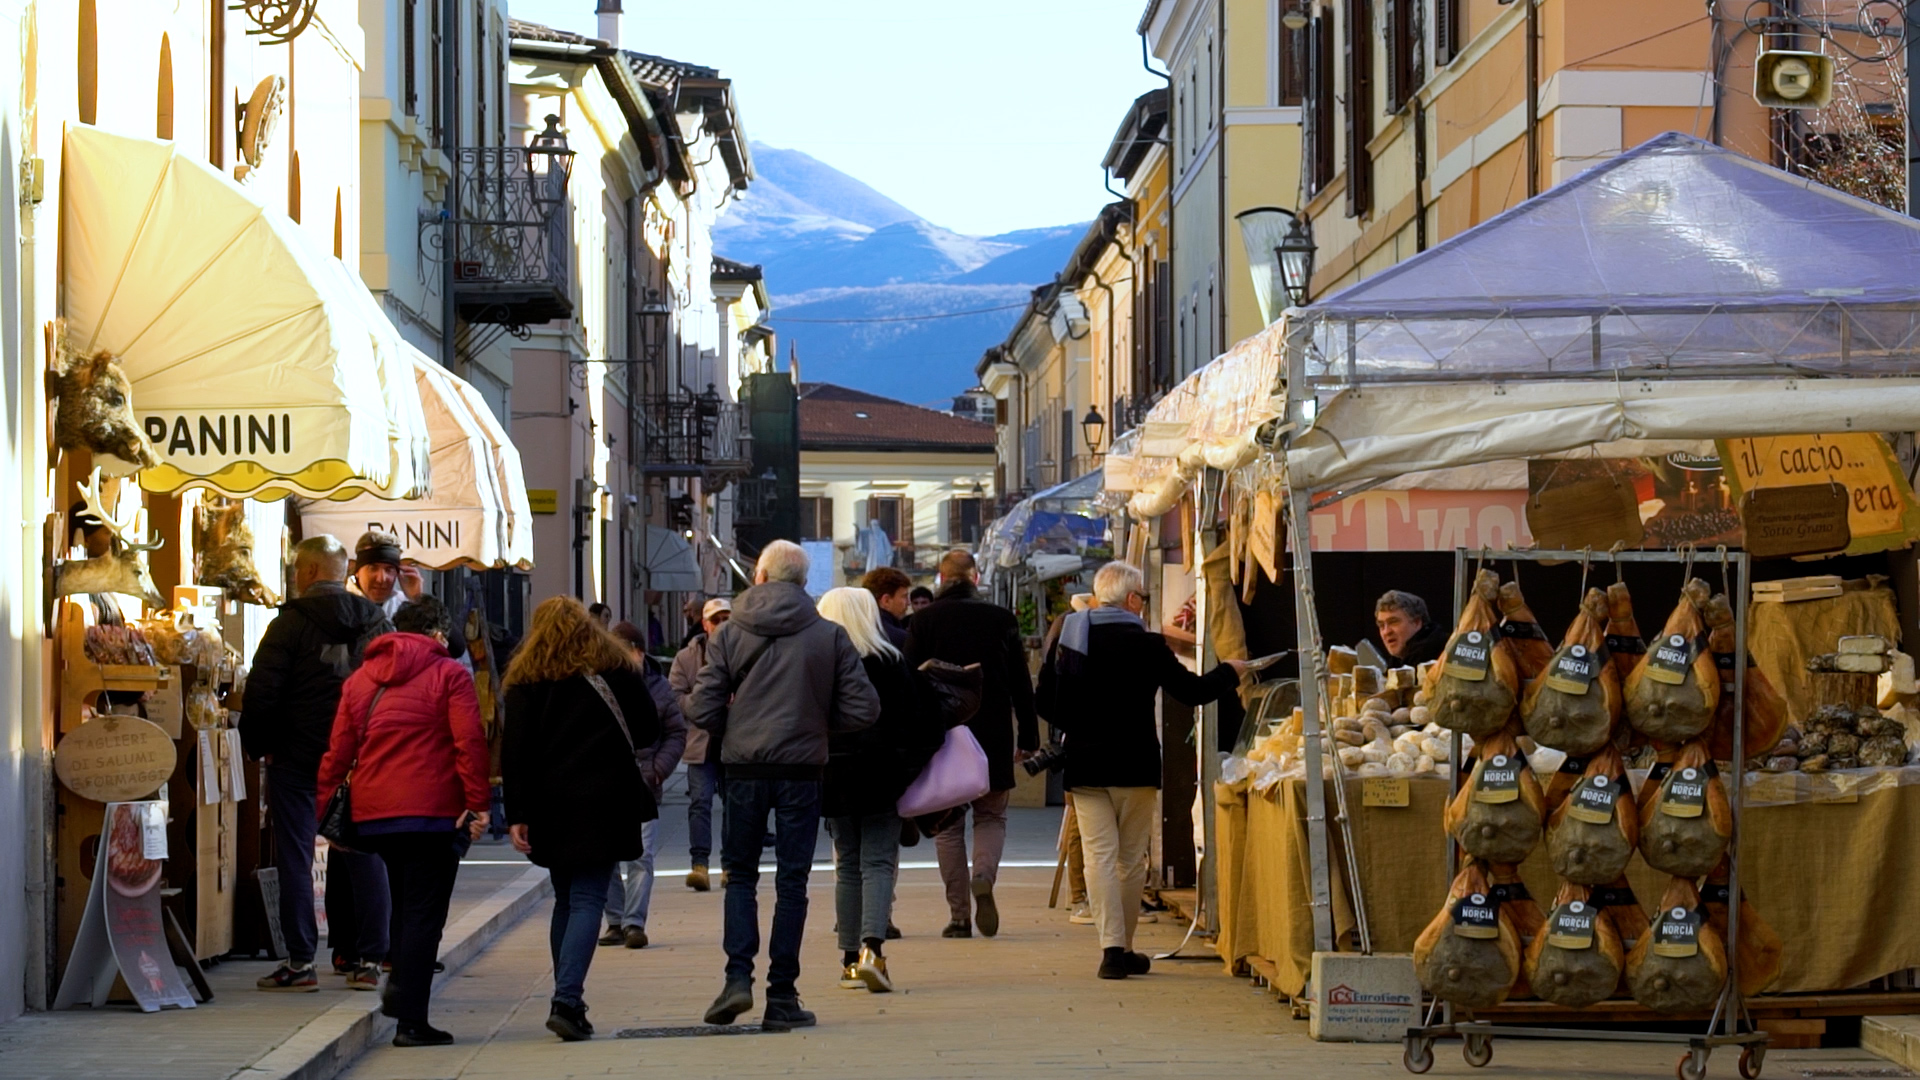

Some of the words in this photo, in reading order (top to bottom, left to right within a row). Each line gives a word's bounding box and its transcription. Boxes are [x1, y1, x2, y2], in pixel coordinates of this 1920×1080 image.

[144, 413, 291, 456] PANINI
[1741, 437, 1763, 478] il
[1760, 525, 1793, 539] Sotto
[1454, 645, 1486, 662] NORCIA
[1656, 648, 1688, 666] NORCIA
[1558, 659, 1590, 675] NORCIA
[73, 732, 149, 750] TAGLIERI
[71, 758, 92, 772] DI
[95, 751, 157, 769] SALUMI
[1483, 771, 1516, 783] NORCIA
[1580, 789, 1612, 805] NORCIA
[1671, 784, 1702, 797] NORCIA
[1461, 908, 1494, 920] NORCIA
[1558, 916, 1590, 929] NORCIA
[1662, 924, 1694, 936] NORCIA
[1354, 992, 1411, 1003] Eurofiere
